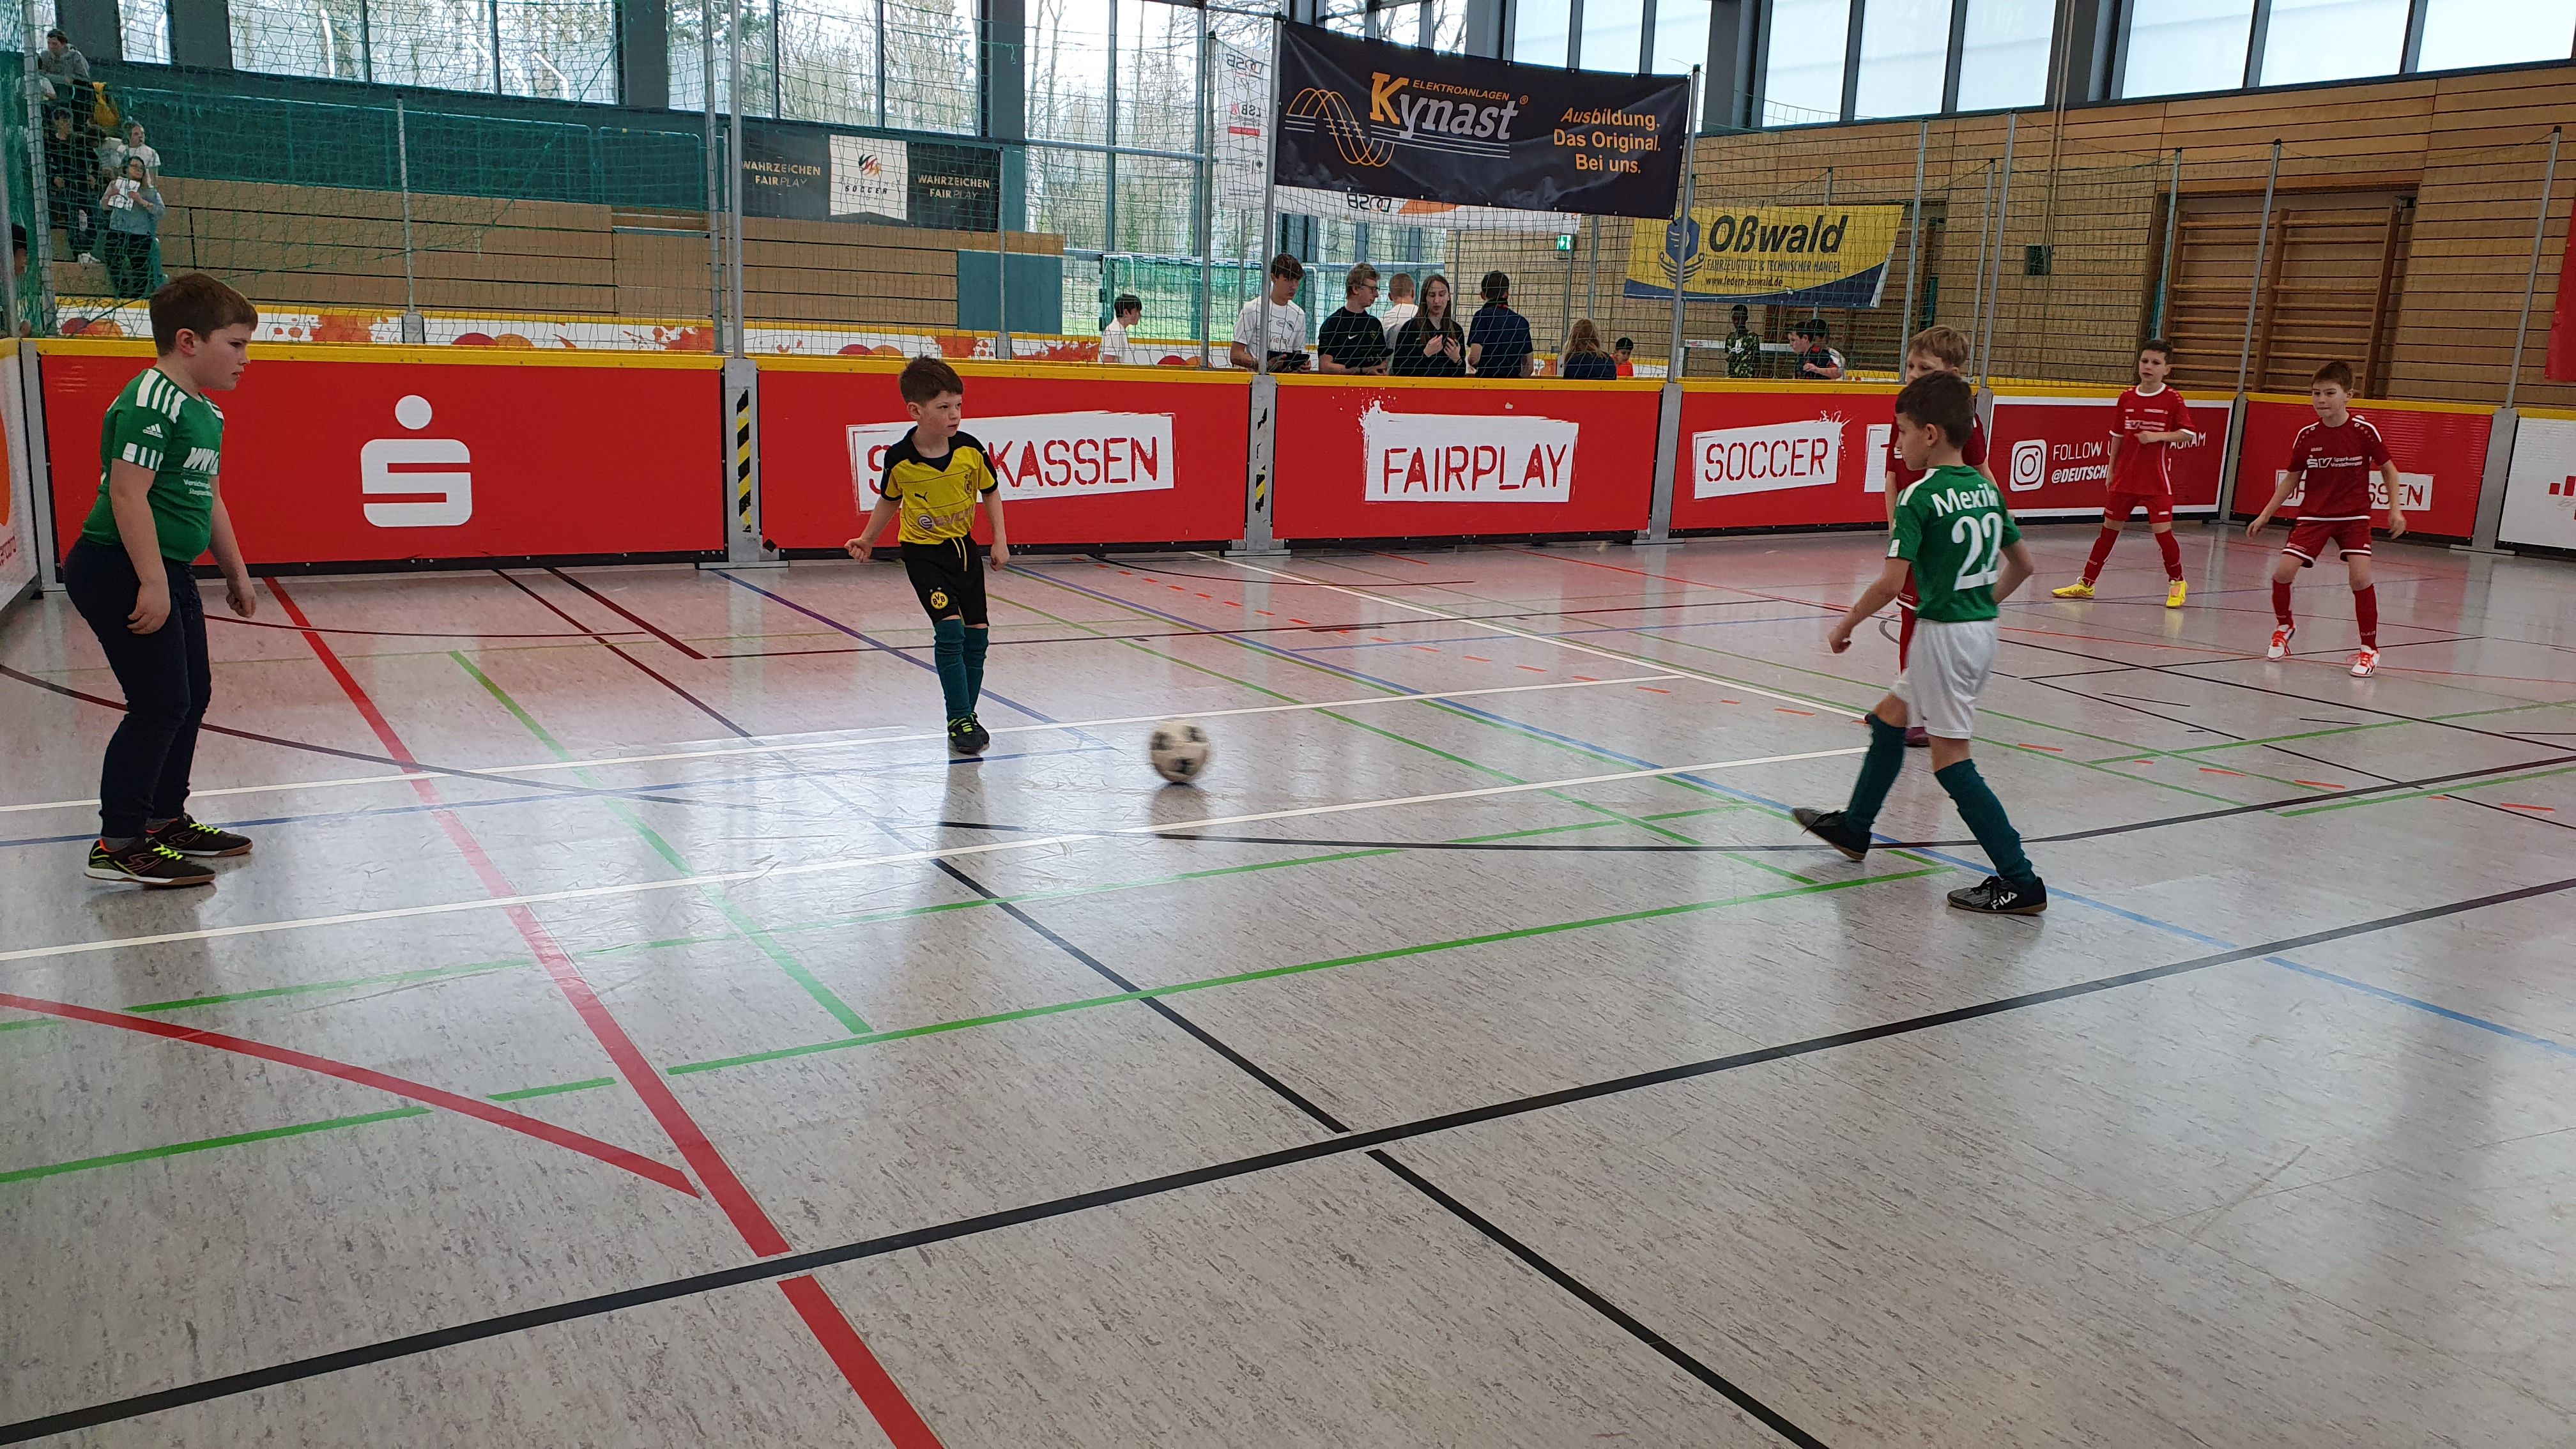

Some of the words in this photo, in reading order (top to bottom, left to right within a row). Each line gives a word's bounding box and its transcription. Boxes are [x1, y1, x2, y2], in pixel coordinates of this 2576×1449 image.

[1413, 80, 1509, 100] ELEKTROANLAGEN
[1370, 72, 1519, 140] Kynast
[1561, 107, 1660, 131] Ausbildung.
[1553, 129, 1586, 146] Das
[1591, 131, 1661, 153] Original.
[741, 160, 821, 176] WAHRZEICHEN
[1575, 153, 1603, 171] Bei
[1609, 158, 1641, 174] uns.
[845, 185, 887, 195] SOCCER
[918, 174, 990, 188] WAHRZEICHEN
[1709, 215, 1848, 253] Oßwald
[1767, 260, 1811, 273] TECHNISCHER
[1814, 261, 1841, 273] HANDEL
[1705, 438, 1828, 482] SOCCER
[2053, 440, 2103, 461] FOLLOW
[868, 436, 1157, 494] SKASSEN
[1384, 443, 1567, 494] FAIRPLAY
[1951, 512, 2004, 591] 22
